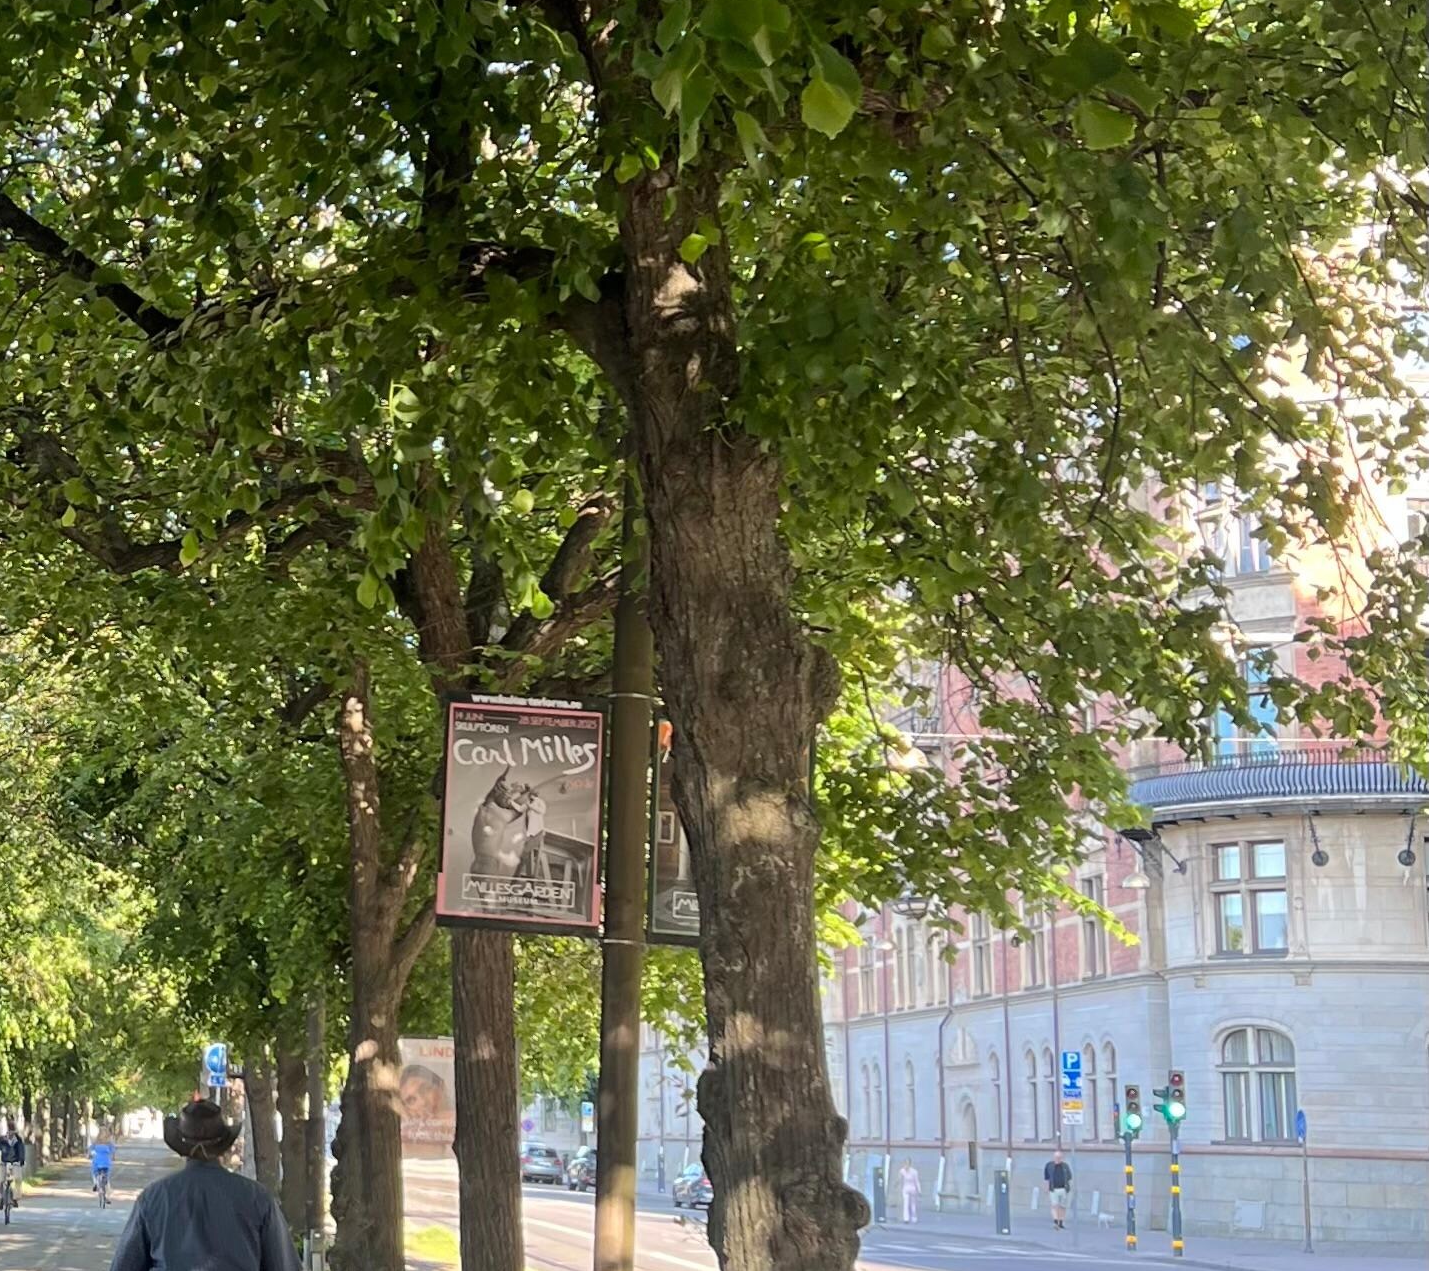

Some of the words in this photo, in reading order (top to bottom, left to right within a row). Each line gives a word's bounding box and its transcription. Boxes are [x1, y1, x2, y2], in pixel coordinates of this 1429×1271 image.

[530, 716, 576, 727] SEPTEMBER
[453, 738, 516, 767] Carl
[520, 735, 598, 775] Milles
[498, 896, 538, 905] MUSEUM
[1067, 1053, 1078, 1068] P
